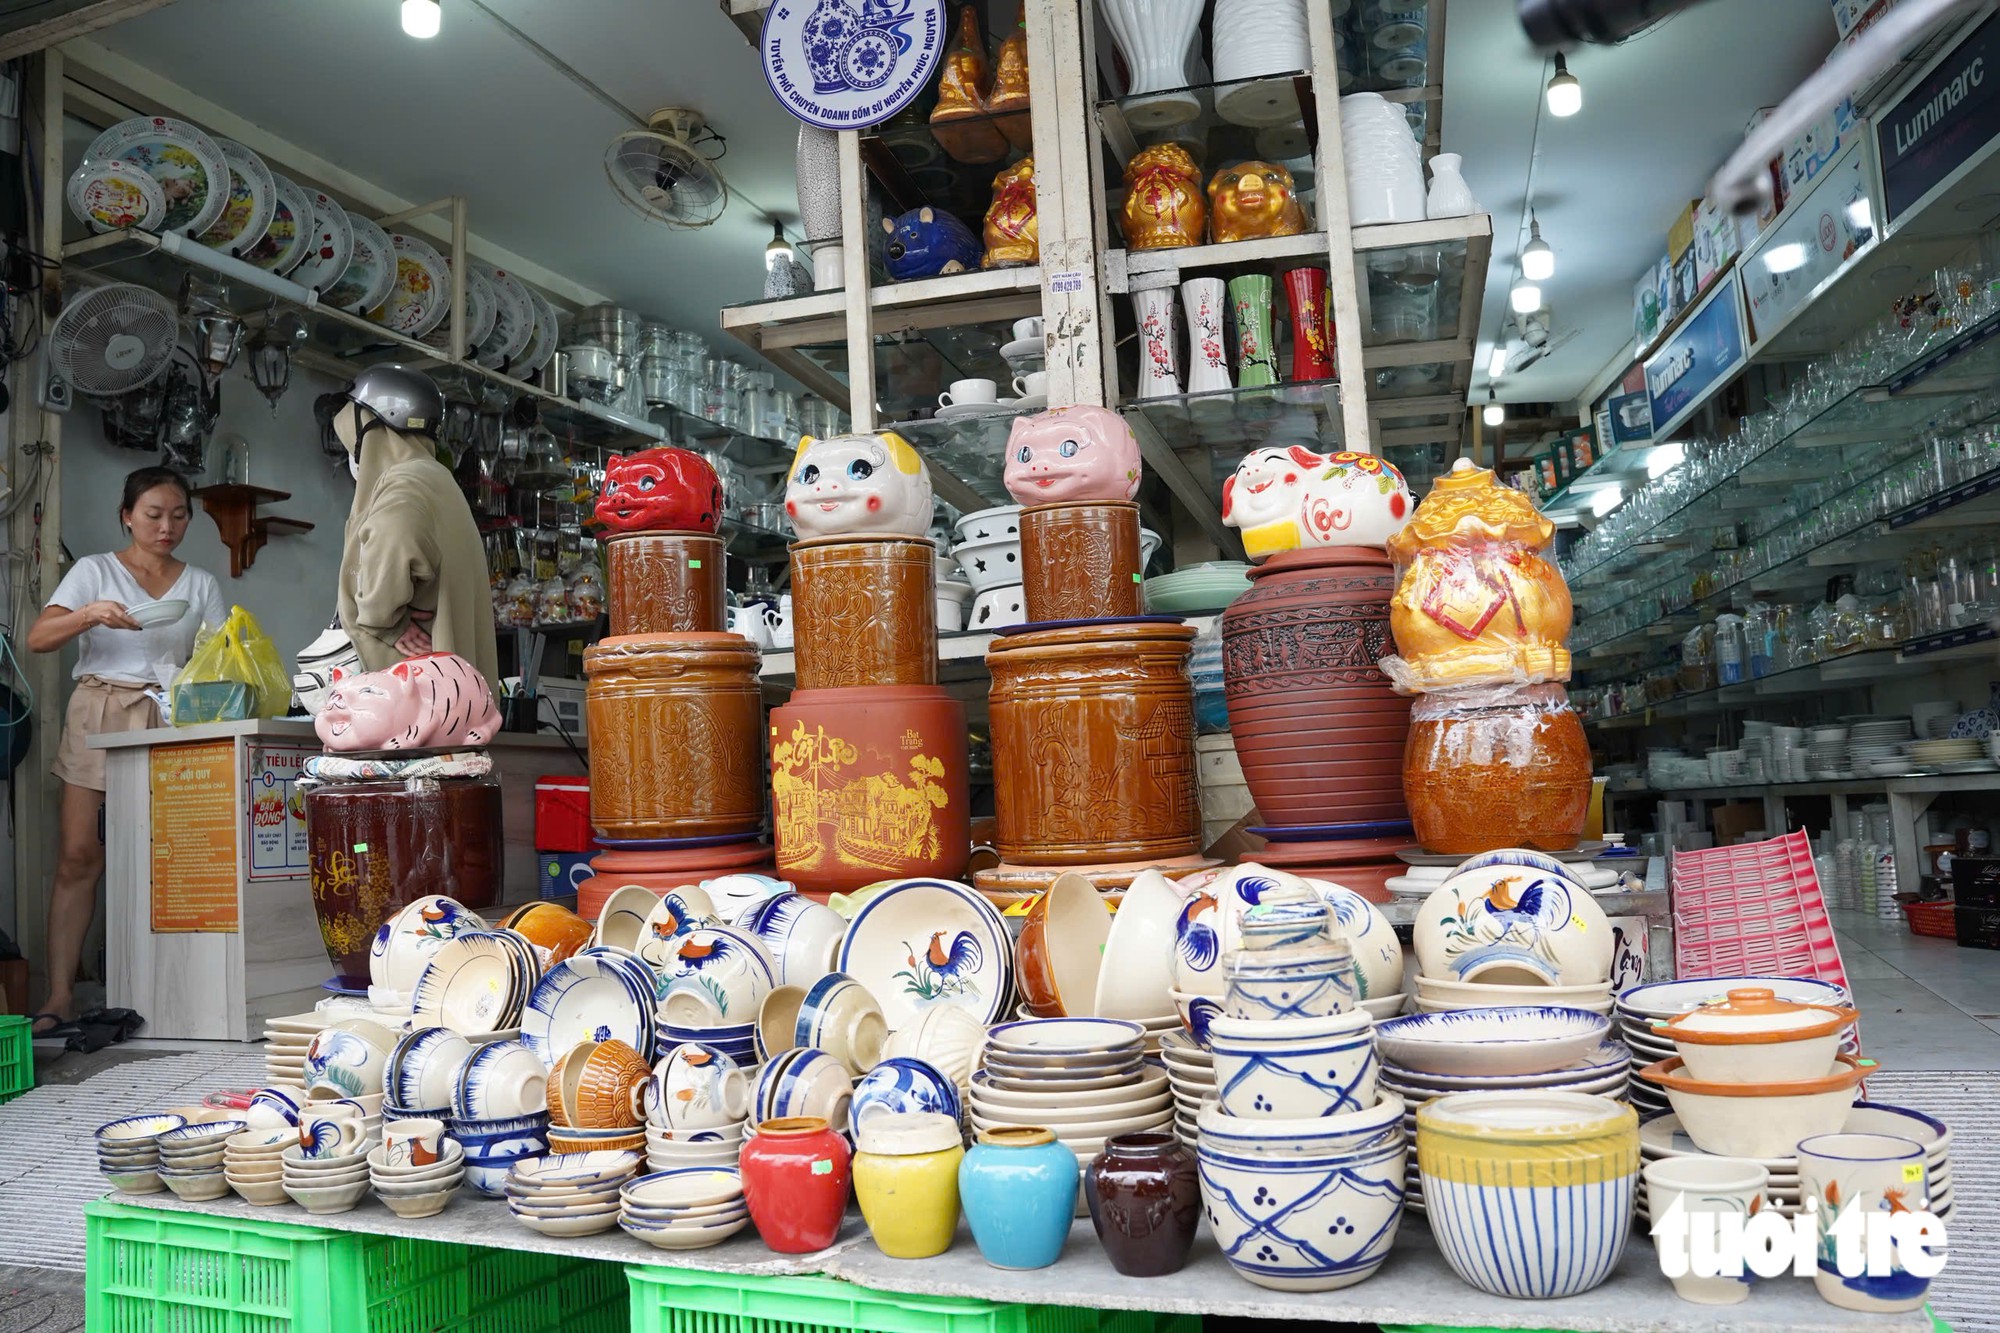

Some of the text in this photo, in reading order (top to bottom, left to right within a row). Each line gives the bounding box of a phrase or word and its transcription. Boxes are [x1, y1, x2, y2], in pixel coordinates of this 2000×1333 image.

[923, 8, 936, 51] NGUYÊN
[771, 38, 783, 74] TUYẾN
[912, 53, 930, 80] PHÚC
[776, 72, 793, 93] PHỐ
[789, 90, 820, 116] CHUYÊN
[851, 106, 871, 120] GỐM
[871, 101, 885, 115] SỨ
[1894, 56, 1984, 156] Luminarc
[821, 109, 850, 121] DOANH
[1652, 347, 1692, 400] Luminarc
[266, 753, 287, 767] TIÊU
[265, 774, 271, 784] 1
